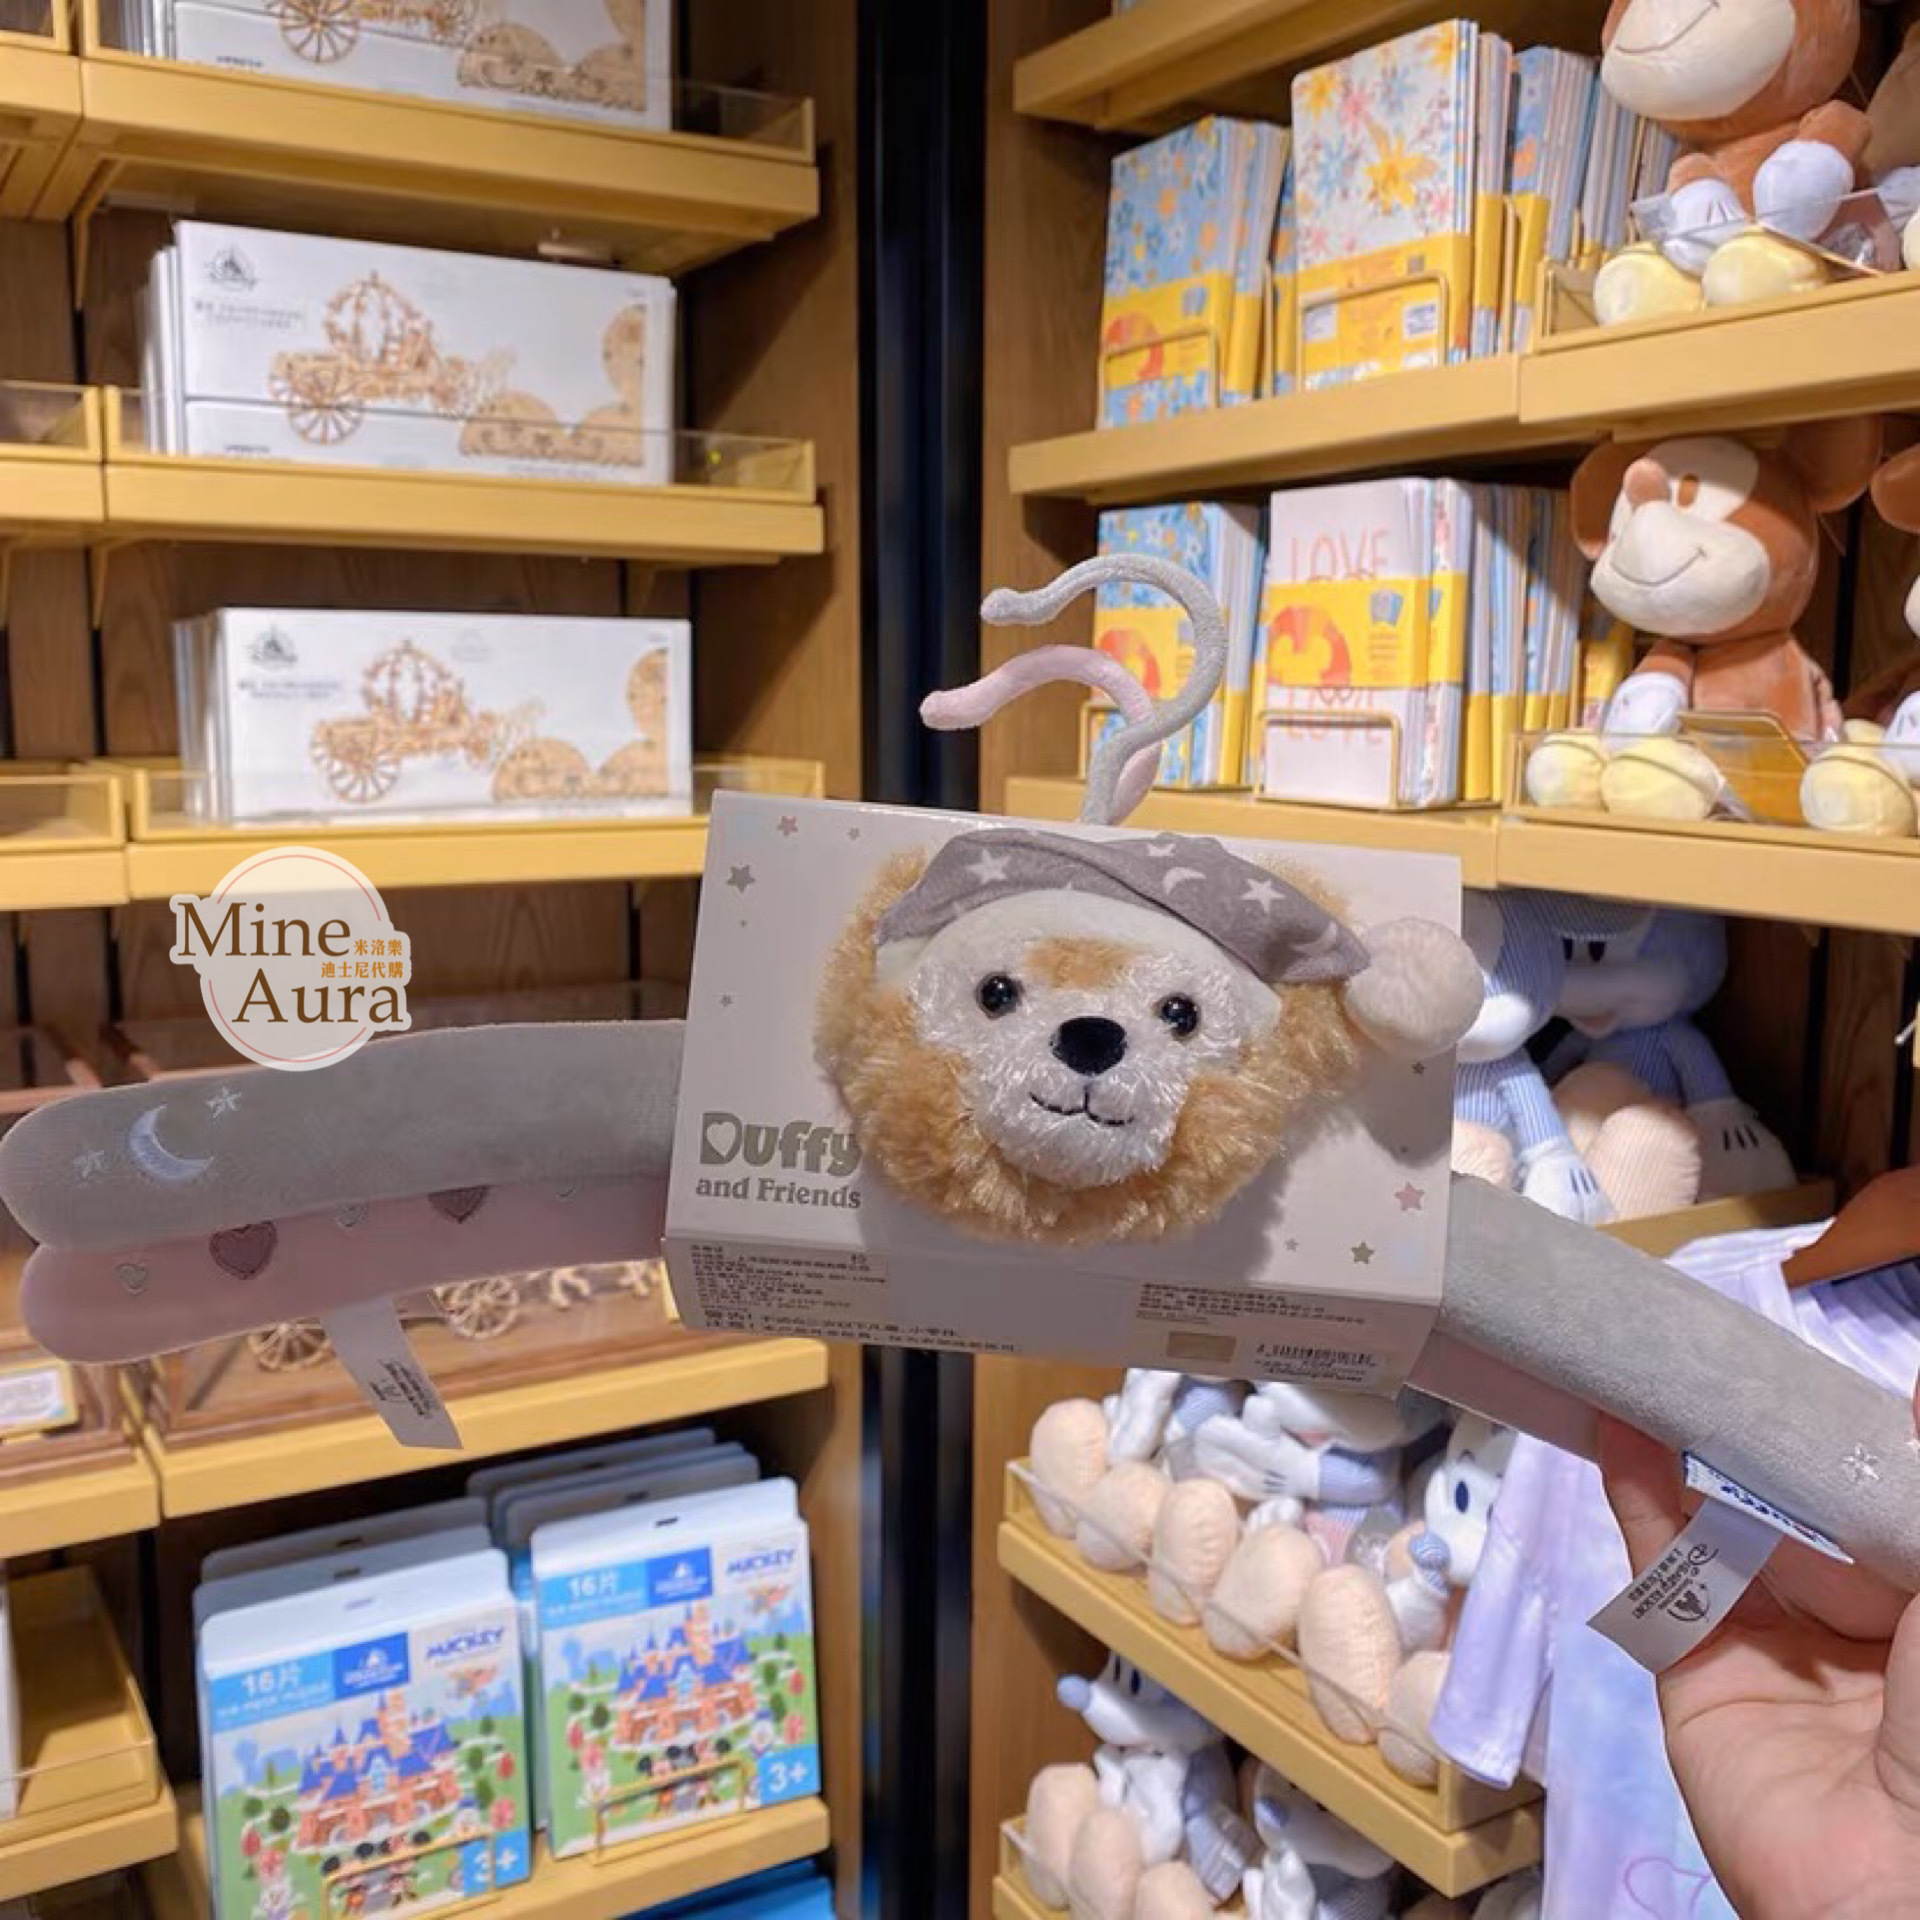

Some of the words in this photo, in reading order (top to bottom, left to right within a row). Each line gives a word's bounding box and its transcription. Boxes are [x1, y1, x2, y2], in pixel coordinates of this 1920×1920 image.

[699, 1112, 863, 1177] Duffy
[695, 1177, 751, 1200] and
[757, 1178, 862, 1209] Friends
[769, 1760, 808, 1793] 3+
[475, 1847, 519, 1883] 3+
